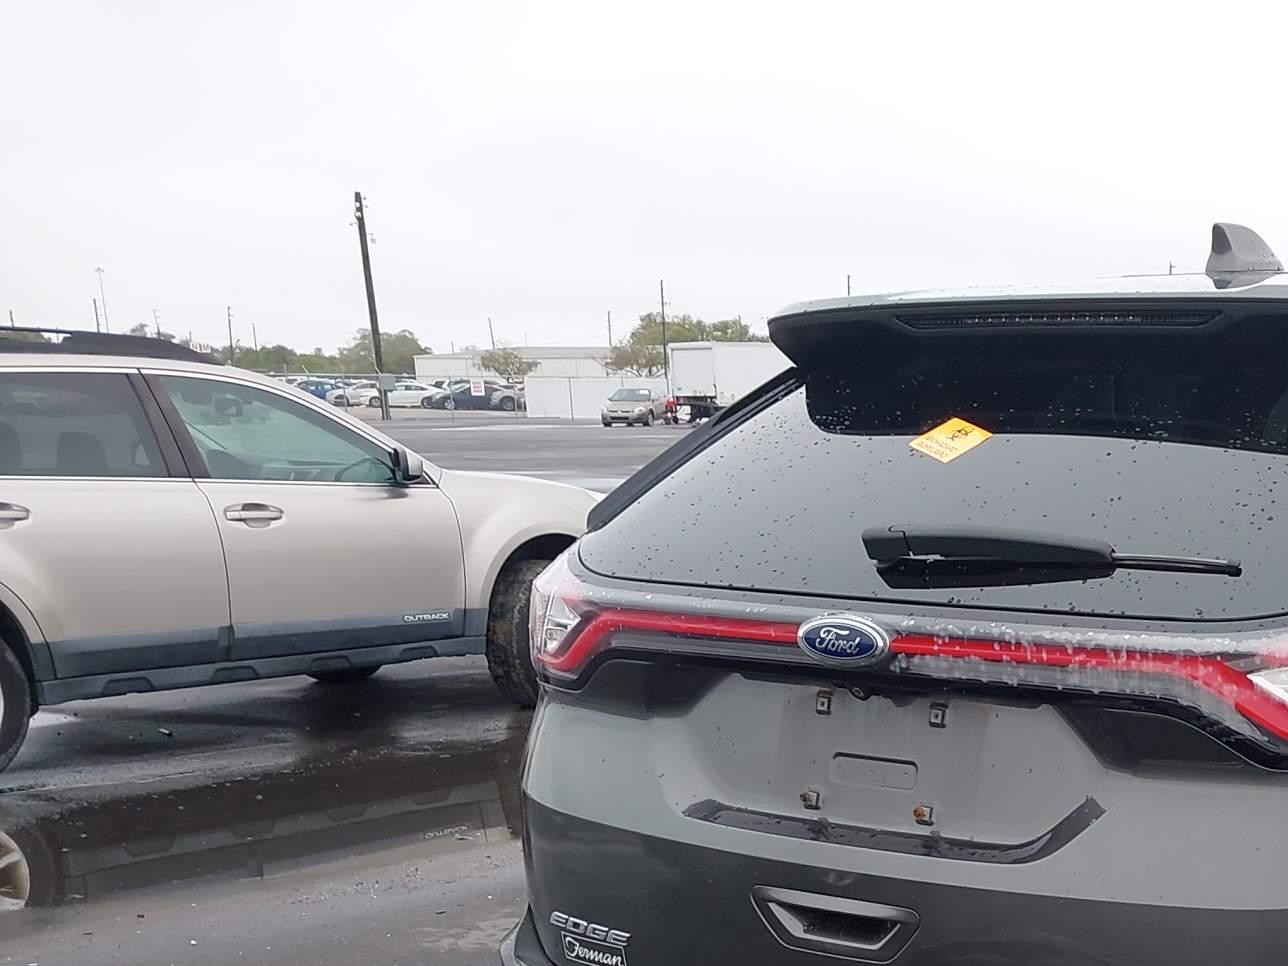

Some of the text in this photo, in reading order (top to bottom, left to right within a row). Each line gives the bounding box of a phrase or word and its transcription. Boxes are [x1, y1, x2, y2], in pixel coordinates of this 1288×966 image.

[403, 612, 450, 623] OUTBACK
[815, 626, 861, 655] Ford
[549, 911, 632, 947] EDGE
